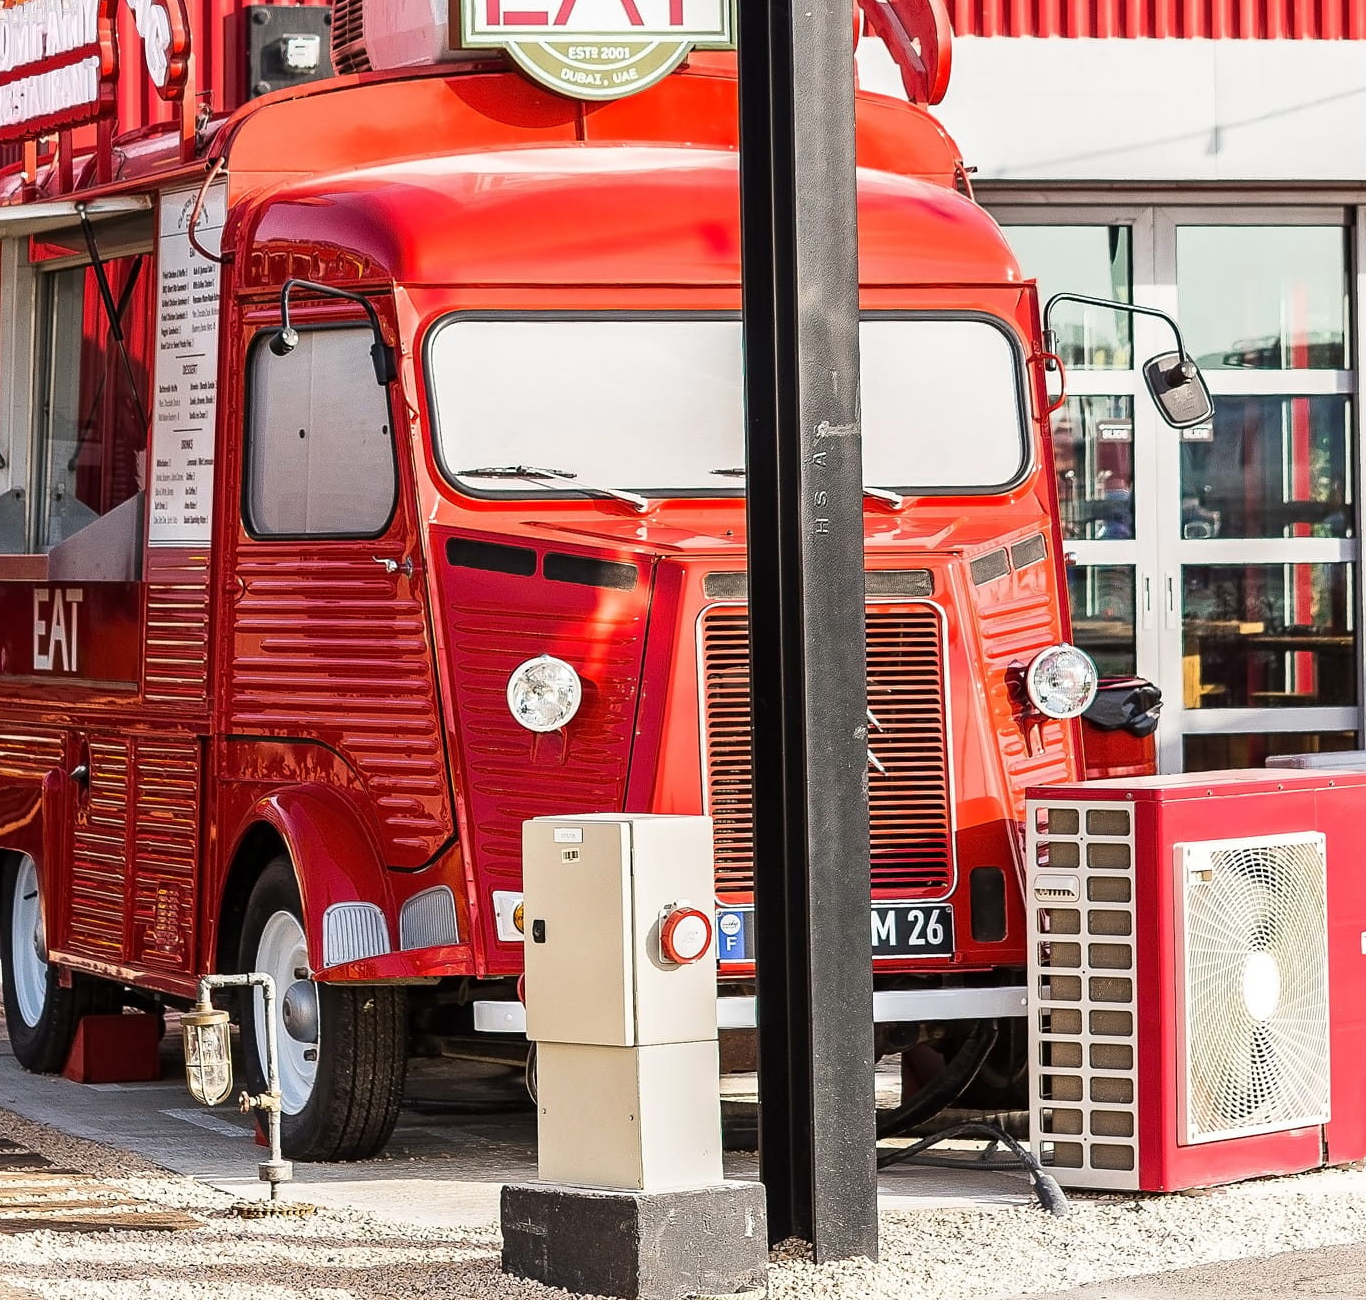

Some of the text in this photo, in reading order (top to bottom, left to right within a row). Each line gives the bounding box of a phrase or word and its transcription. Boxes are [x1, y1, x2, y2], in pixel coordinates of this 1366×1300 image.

[600, 46, 631, 59] 2001
[612, 67, 639, 84] UAE
[33, 588, 83, 672] EAT
[908, 909, 944, 946] 26
[726, 936, 738, 951] F
